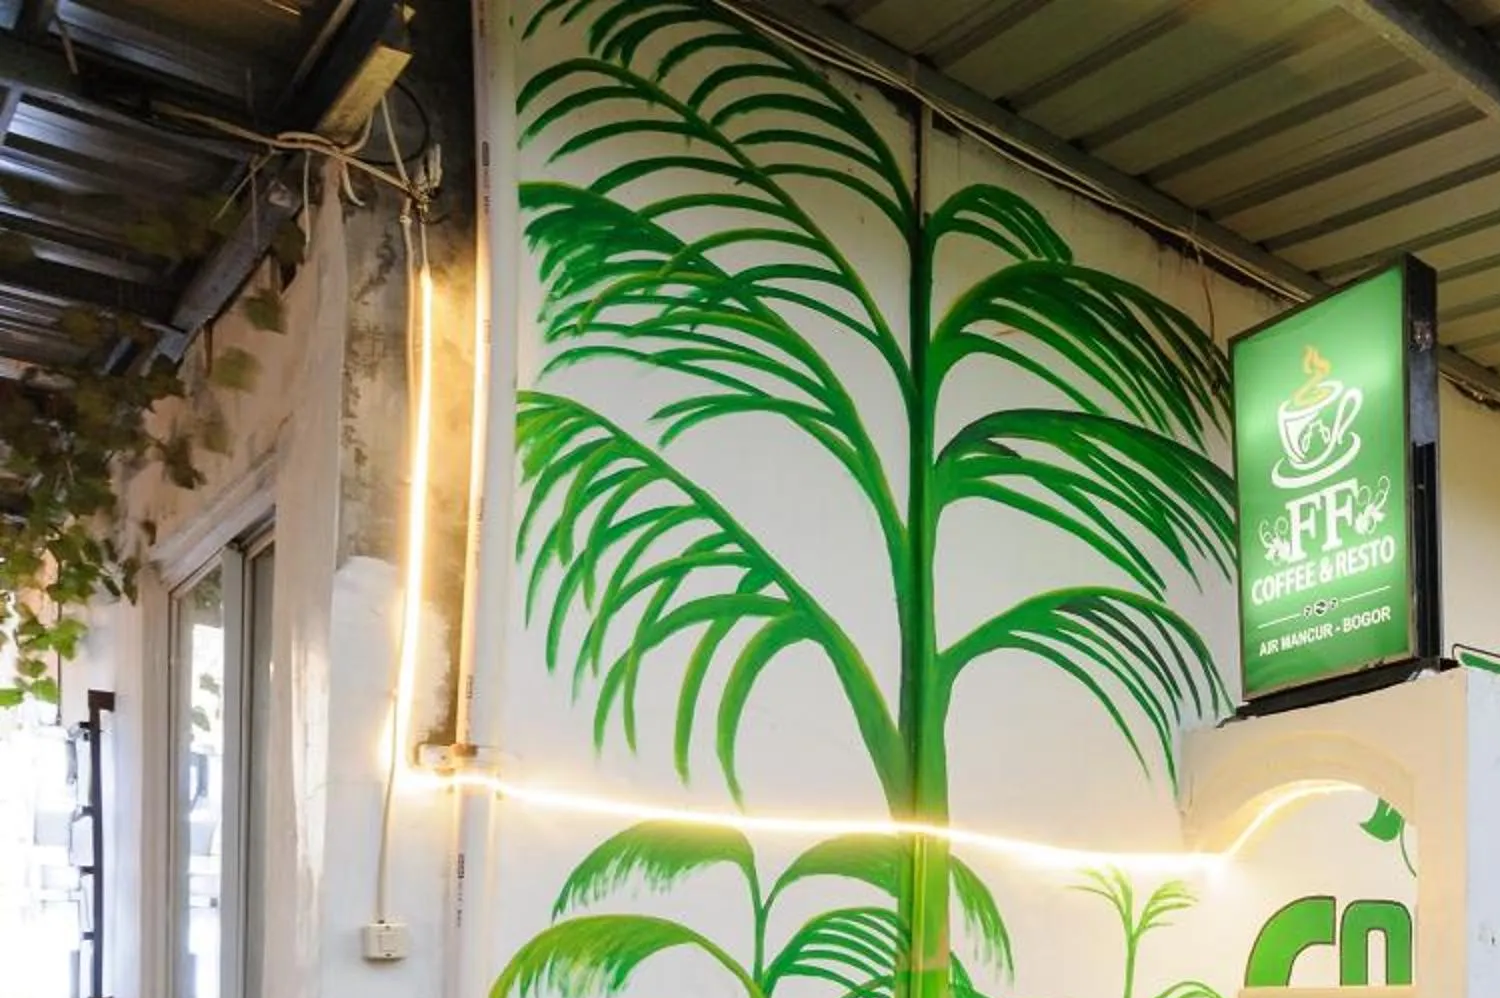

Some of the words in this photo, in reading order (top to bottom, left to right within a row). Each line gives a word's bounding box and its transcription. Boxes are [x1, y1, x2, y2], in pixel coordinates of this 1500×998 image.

[1285, 479, 1359, 562] FF
[1251, 561, 1318, 606] COFFEE
[1319, 556, 1334, 583] &
[1335, 535, 1395, 578] RESTO
[1259, 638, 1279, 656] AIR
[1281, 623, 1333, 651] MANCUR
[1343, 605, 1392, 633] BOGOR
